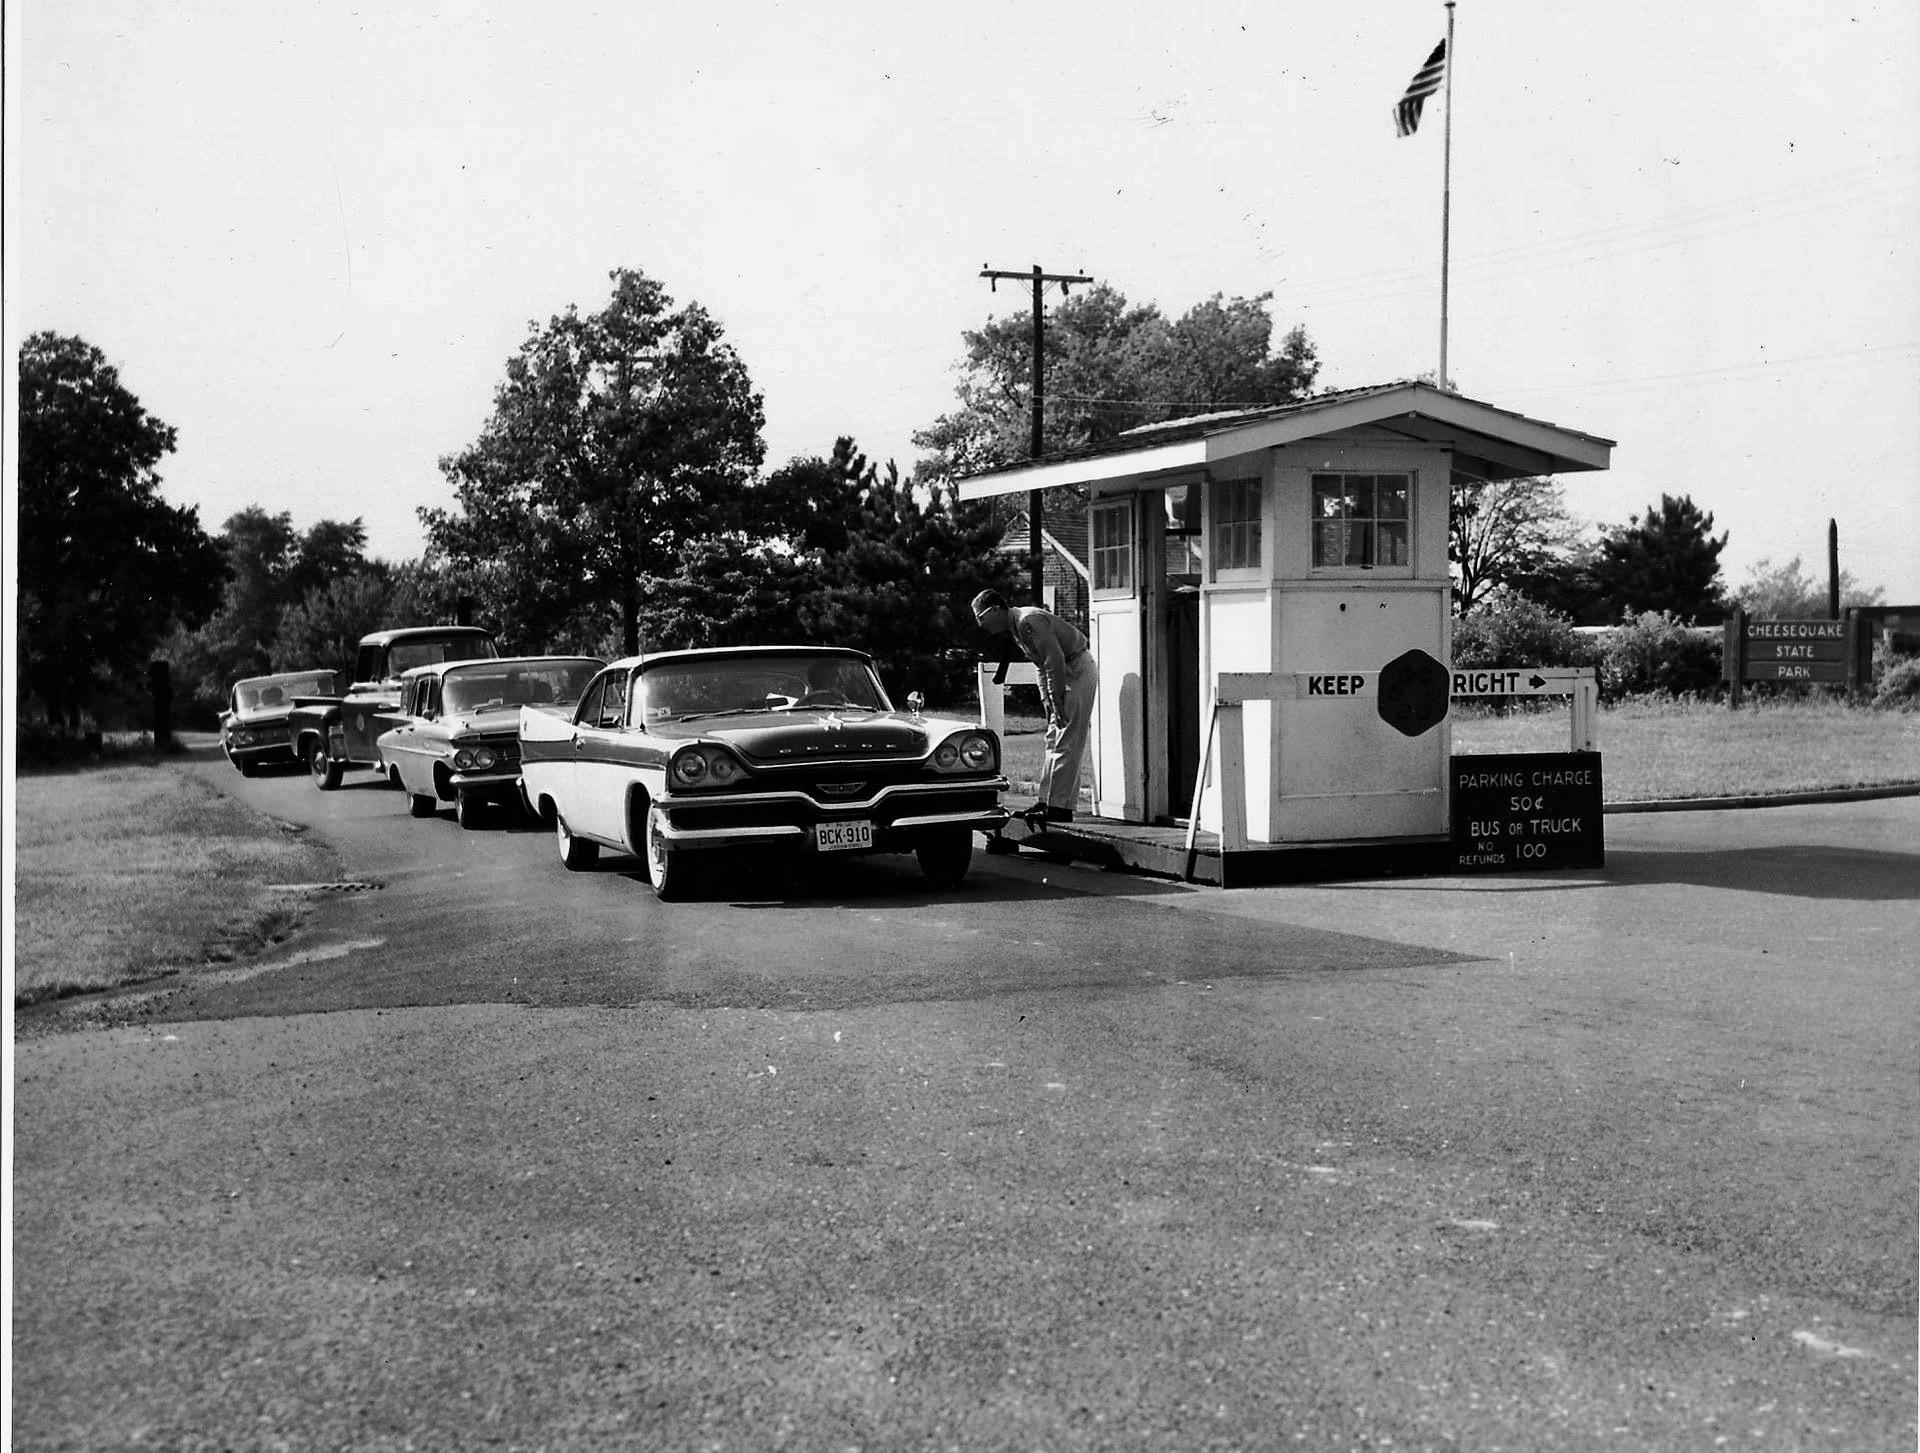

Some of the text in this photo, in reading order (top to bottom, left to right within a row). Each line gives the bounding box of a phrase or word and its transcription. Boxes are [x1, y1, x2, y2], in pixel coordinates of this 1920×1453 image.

[1747, 625, 1844, 637] CHEESEQUAKE
[1776, 645, 1814, 658] STATE
[1778, 666, 1811, 678] PARK
[1308, 672, 1521, 696] KEEP RIGHT
[1459, 770, 1592, 789] PARKING CHARGE
[1471, 818, 1582, 837] BUS OR TRUCK
[1478, 841, 1494, 852] NO
[1459, 854, 1506, 865] REFUNDS
